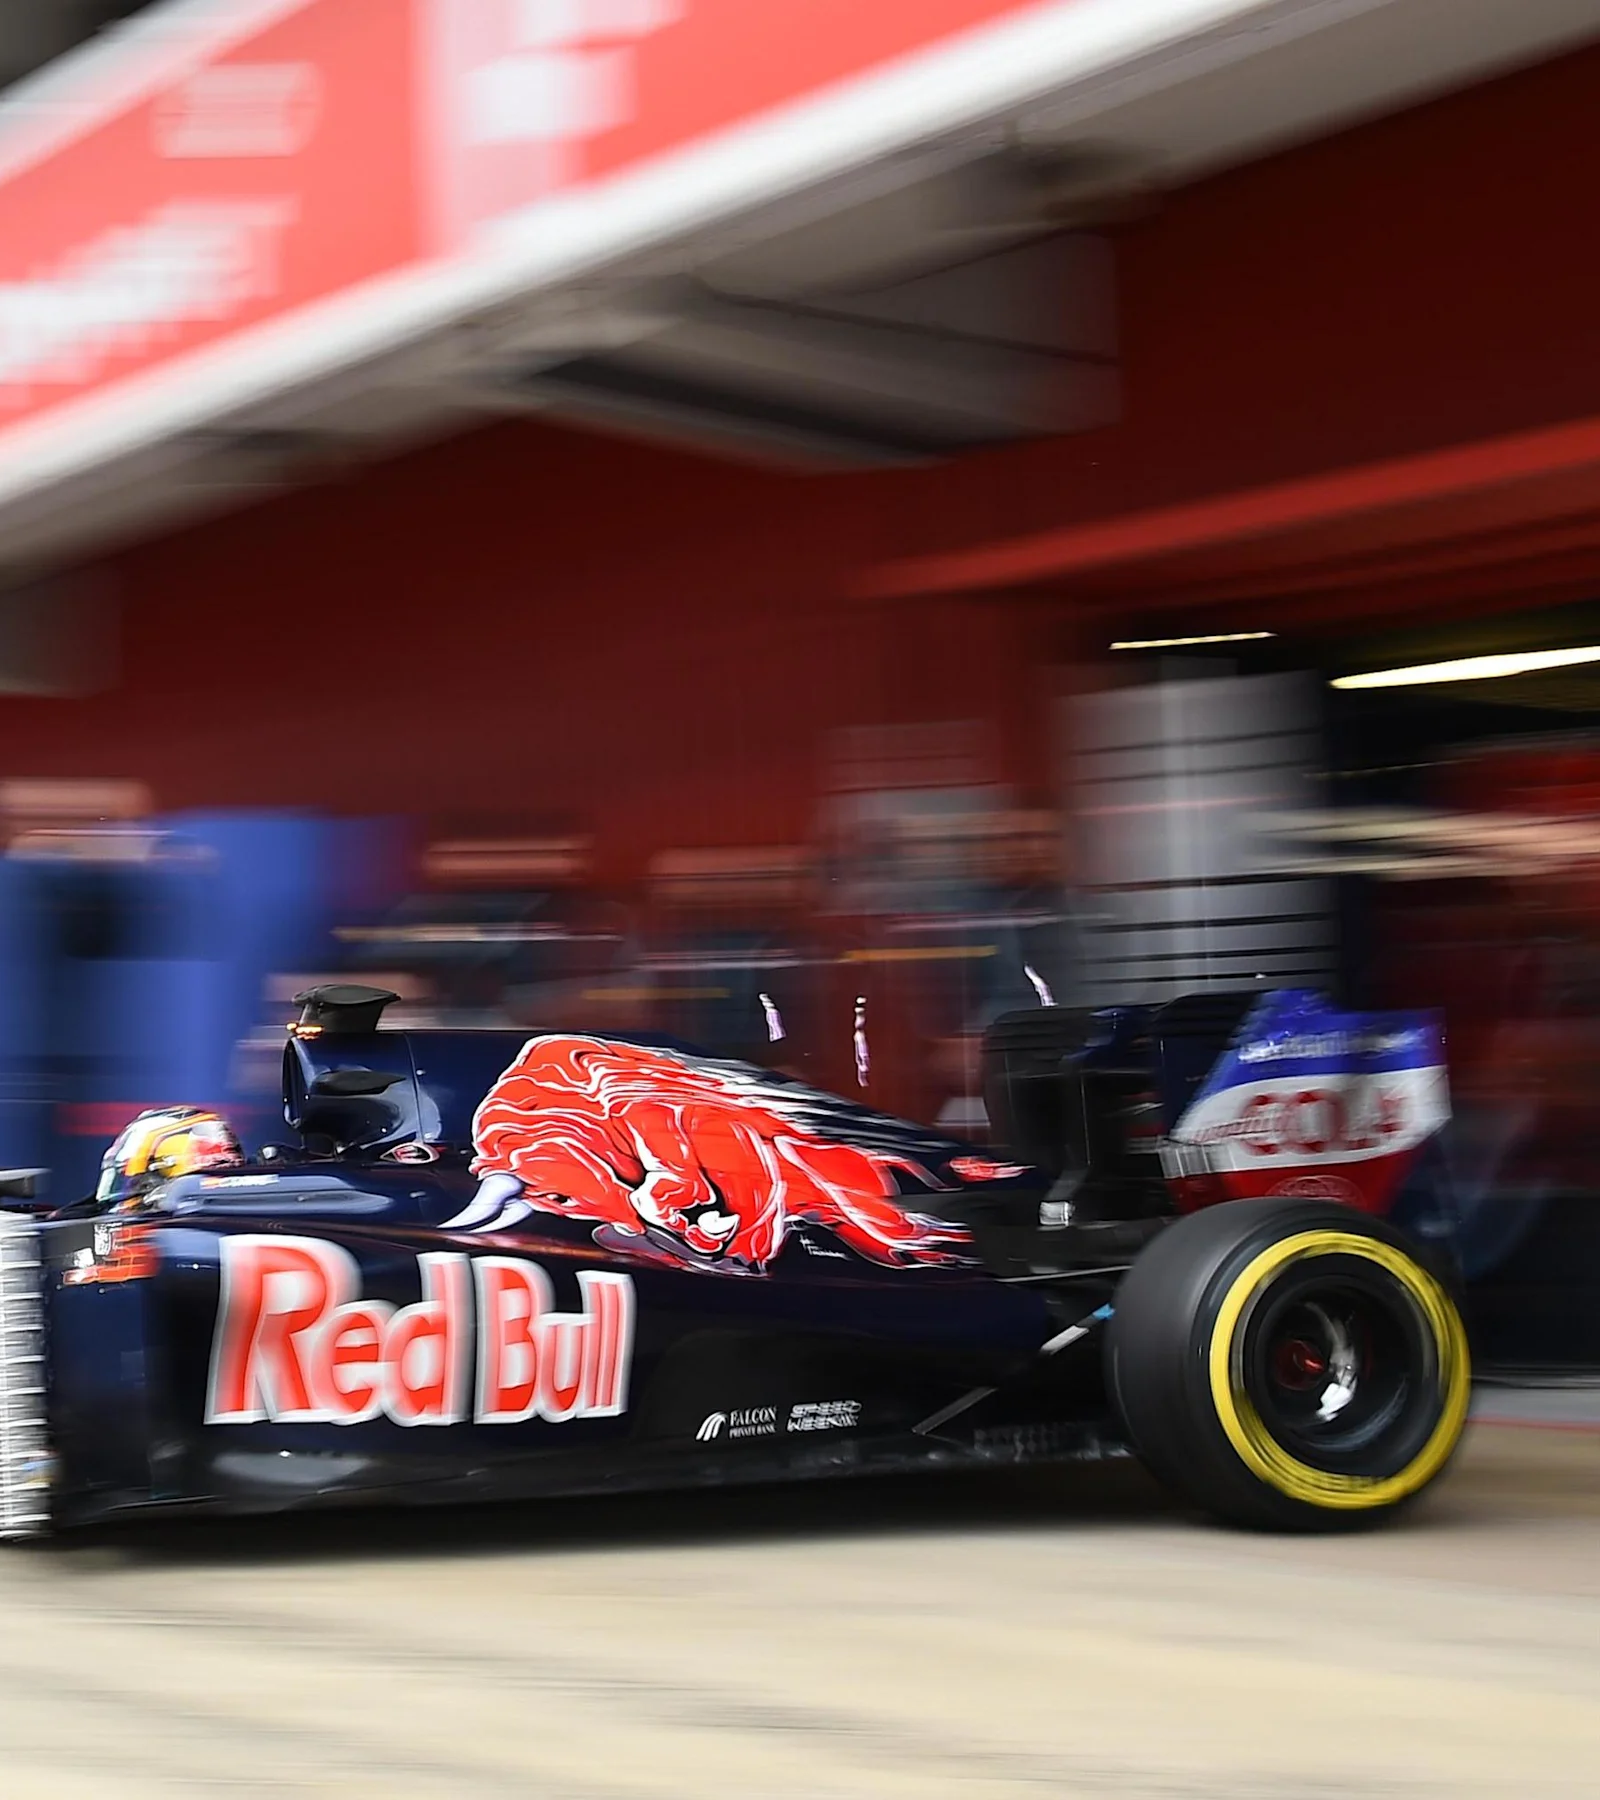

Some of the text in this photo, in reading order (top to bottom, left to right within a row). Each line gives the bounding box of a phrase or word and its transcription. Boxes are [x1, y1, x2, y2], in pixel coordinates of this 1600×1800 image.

[204, 1234, 636, 1427] Red Bull
[730, 1405, 777, 1426] FALCON
[790, 1400, 862, 1418] SPEED
